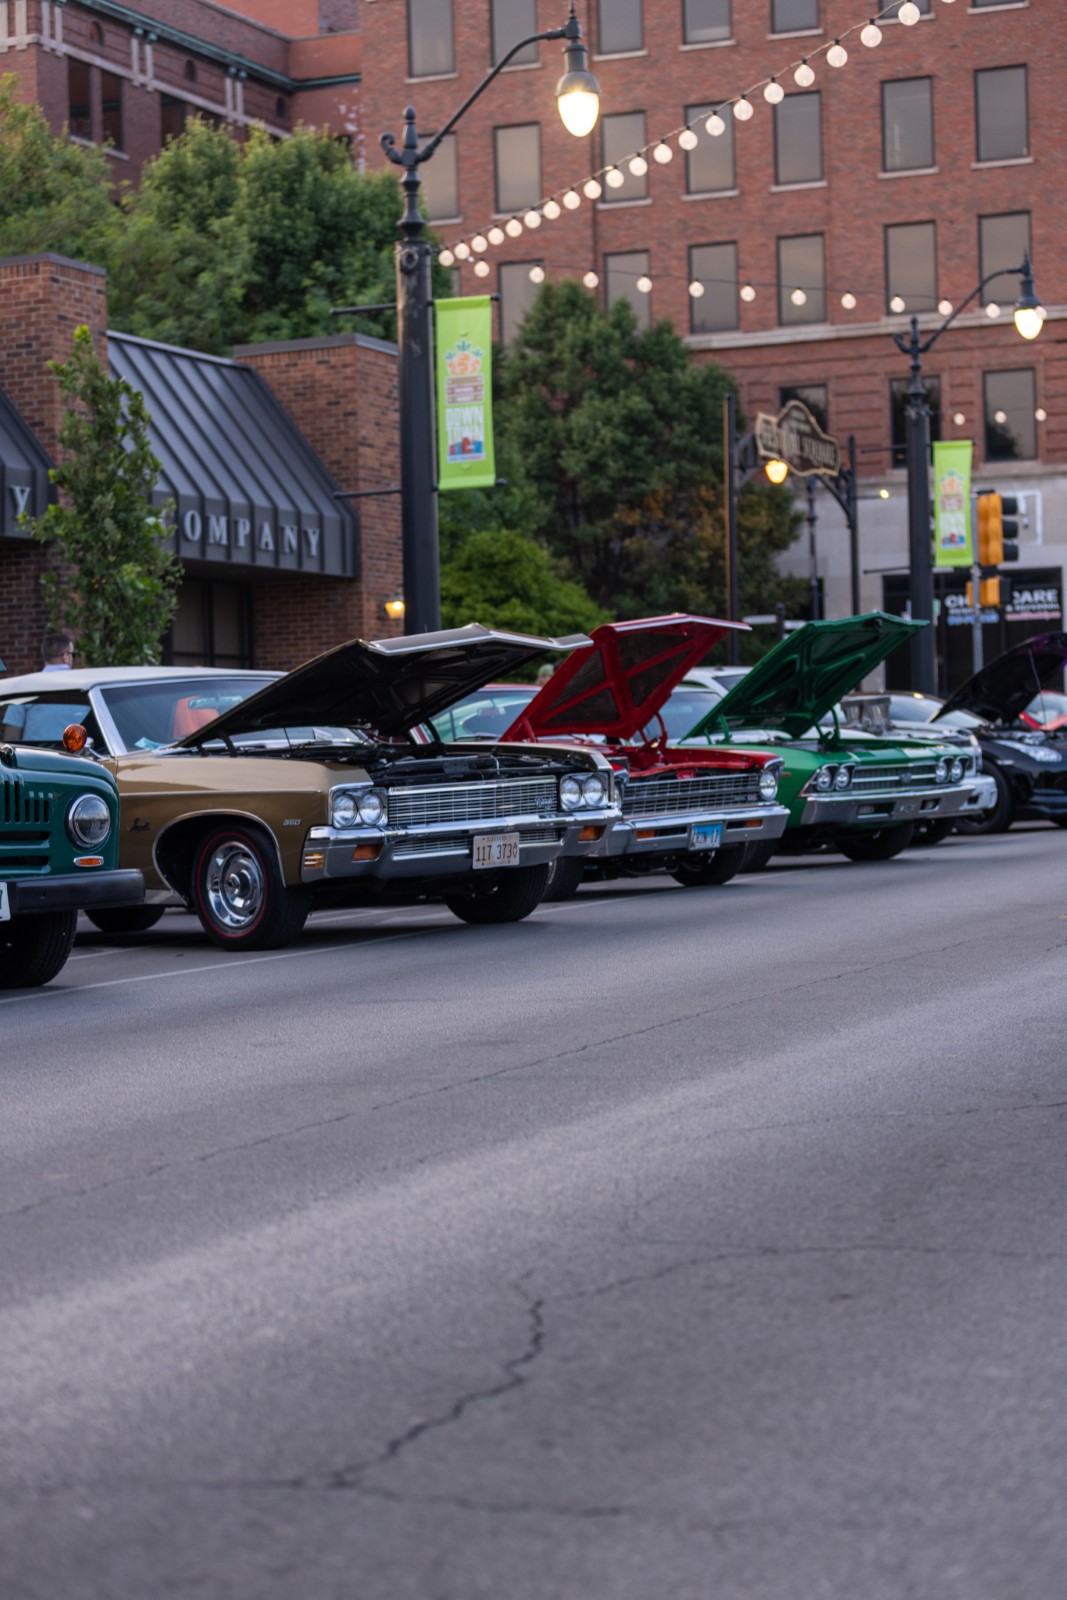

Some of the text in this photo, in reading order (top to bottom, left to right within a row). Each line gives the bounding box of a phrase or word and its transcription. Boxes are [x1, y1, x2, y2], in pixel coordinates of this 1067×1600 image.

[445, 406, 484, 425] DOWN
[802, 437, 836, 467] SQUARE
[157, 509, 320, 556] OMPANY
[475, 845, 492, 862] 117
